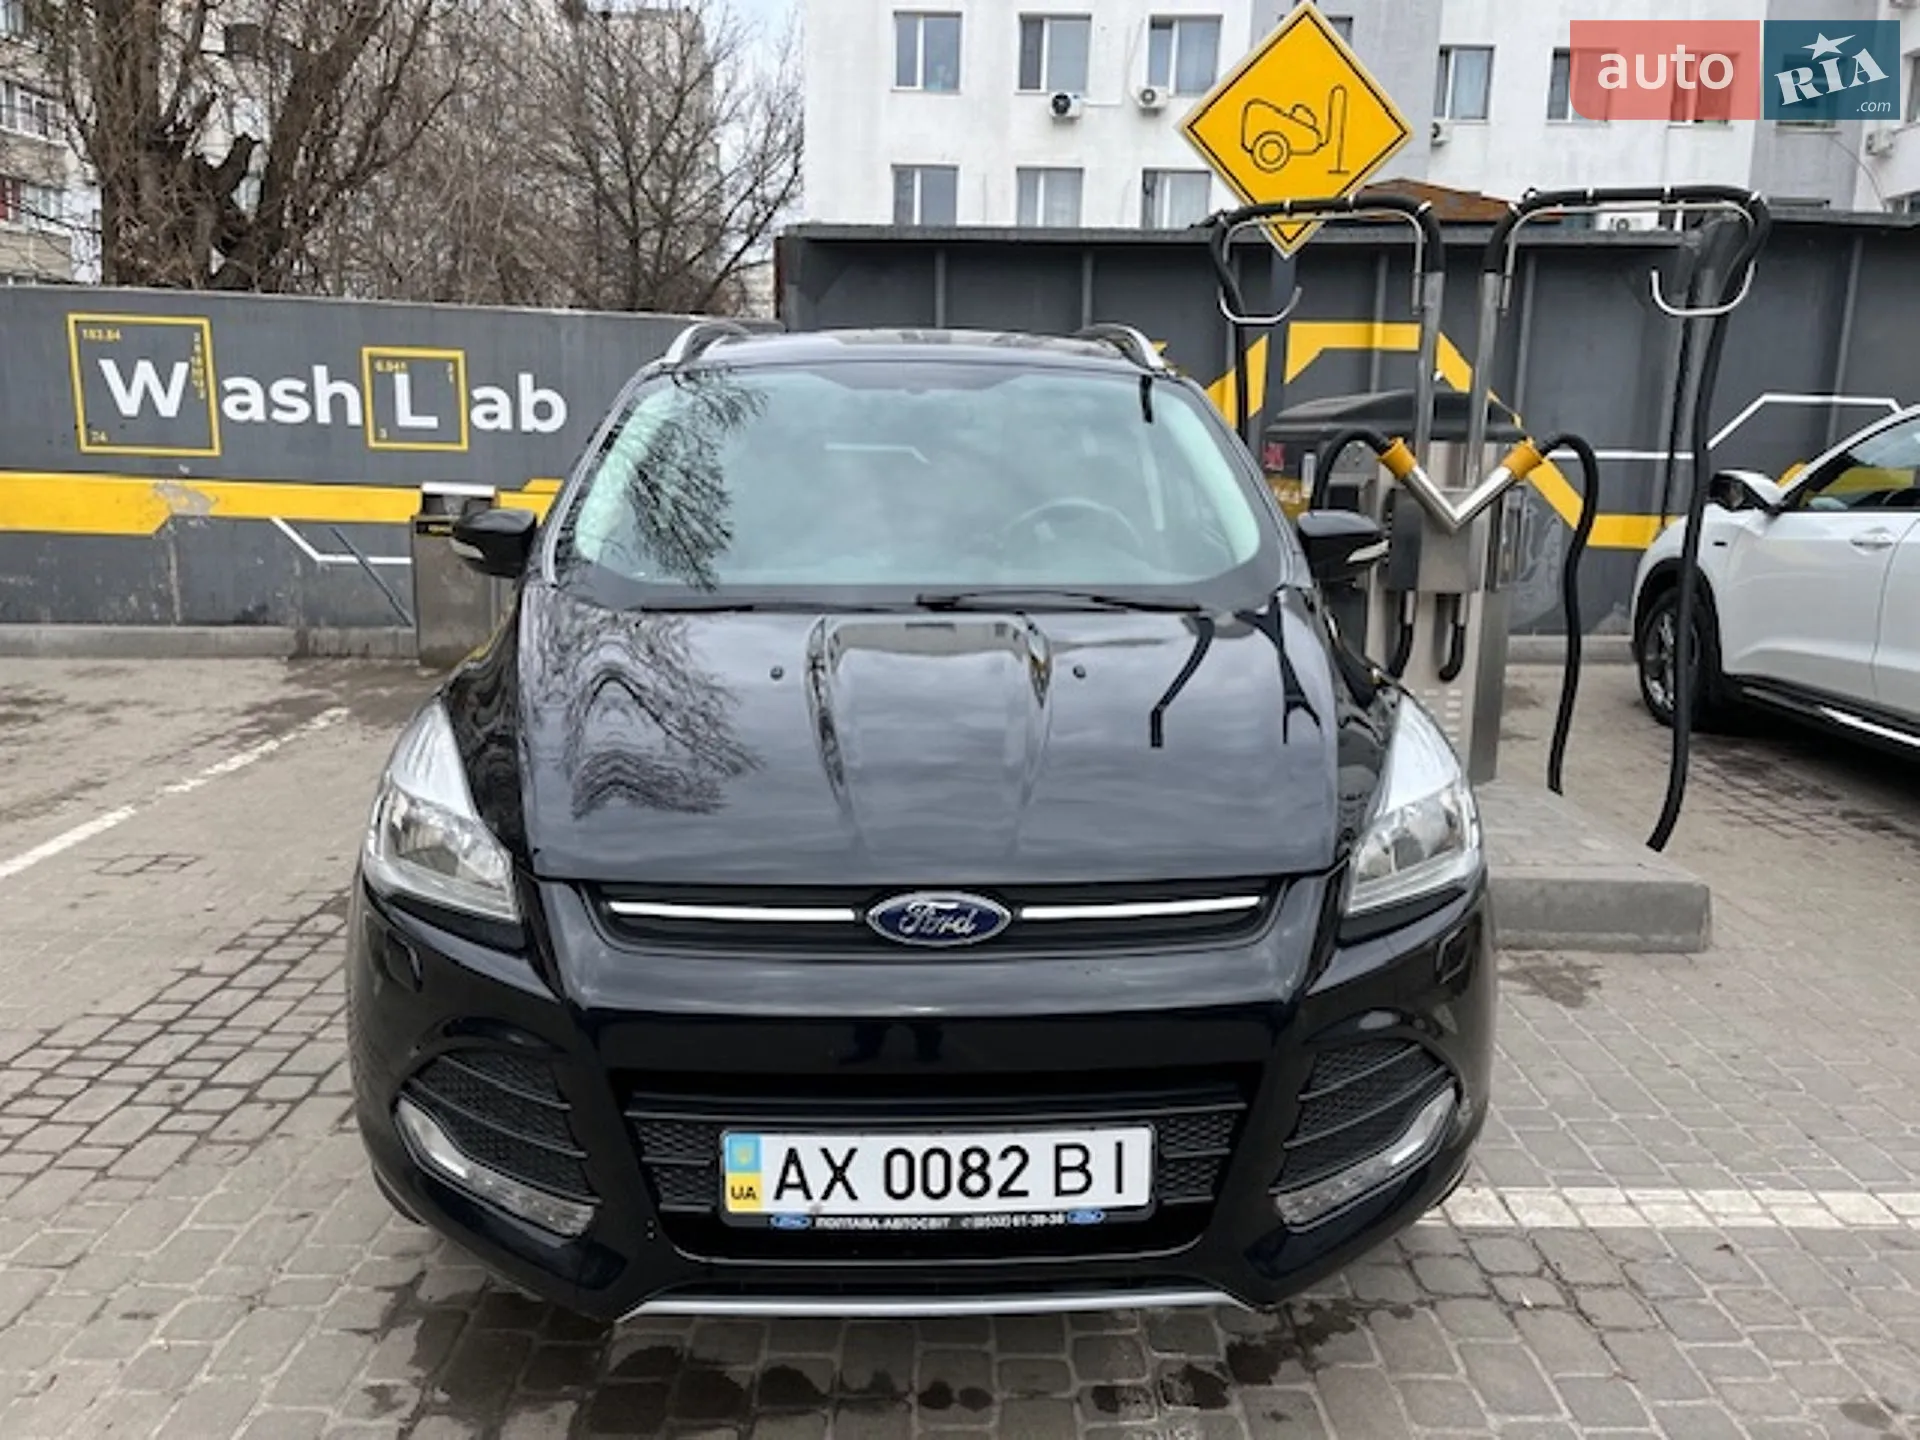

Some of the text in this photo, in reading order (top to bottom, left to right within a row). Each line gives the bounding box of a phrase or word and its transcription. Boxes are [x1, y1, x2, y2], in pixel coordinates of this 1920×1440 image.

[899, 901, 978, 935] Ford
[774, 1146, 859, 1200] AX
[884, 1145, 1030, 1200] 0082
[731, 1186, 757, 1201] UA
